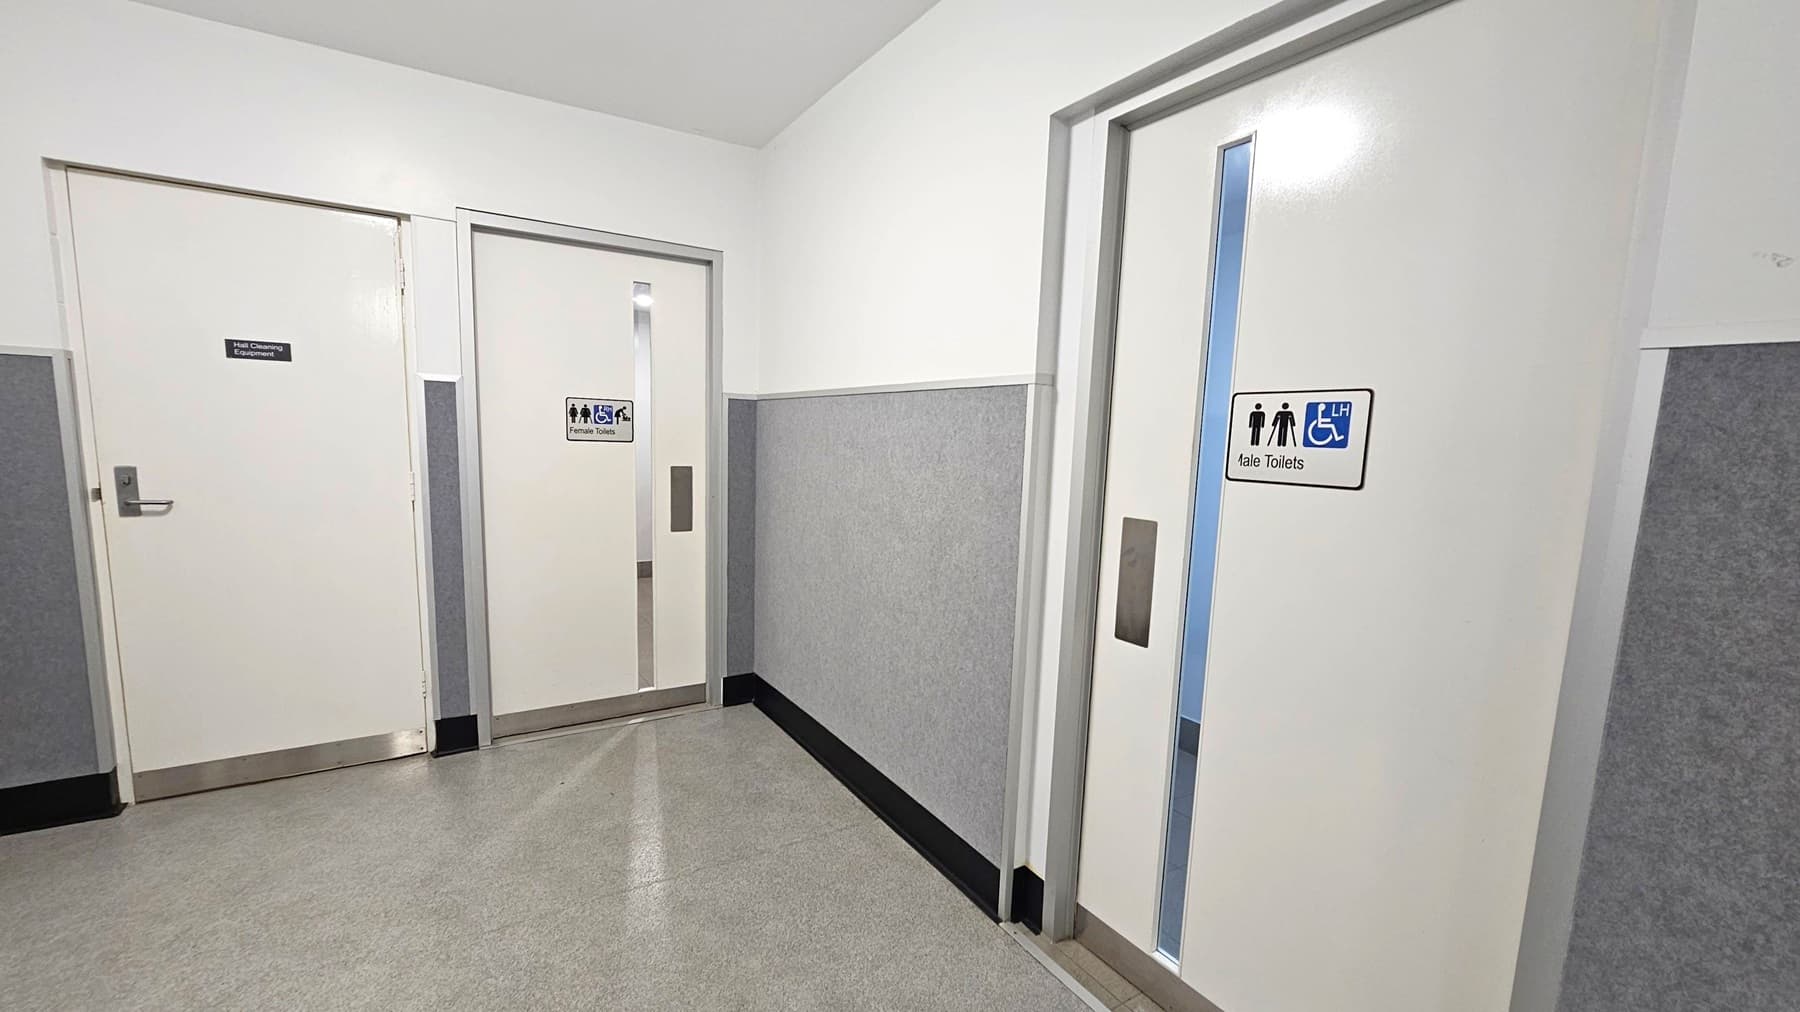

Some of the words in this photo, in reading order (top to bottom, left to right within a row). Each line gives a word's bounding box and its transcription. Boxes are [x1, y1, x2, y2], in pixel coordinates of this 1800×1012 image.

[233, 341, 249, 349] Hall
[250, 342, 283, 352] Cleaning
[234, 348, 275, 357] Equipment
[1331, 403, 1349, 417] LH
[569, 426, 594, 435] Female
[595, 427, 616, 435] Toilets
[1264, 454, 1304, 470] Toilets
